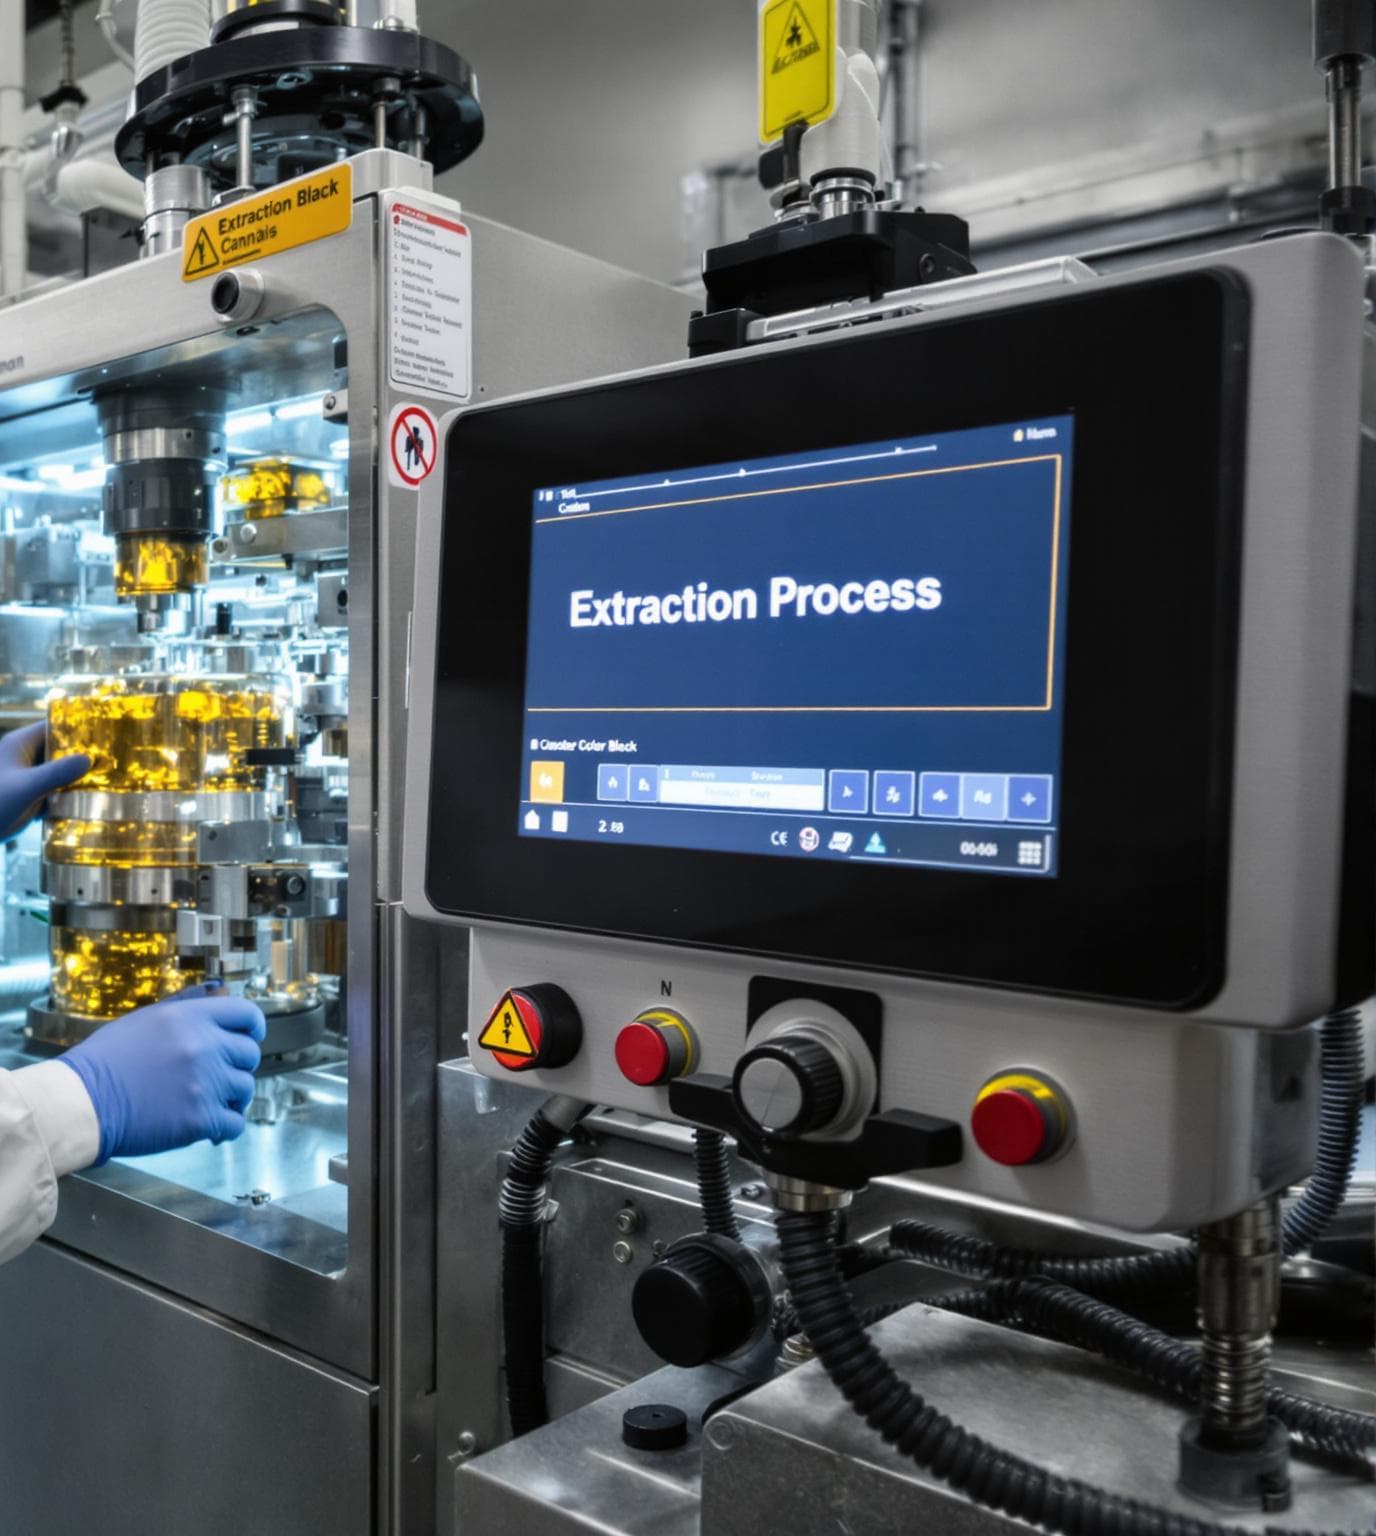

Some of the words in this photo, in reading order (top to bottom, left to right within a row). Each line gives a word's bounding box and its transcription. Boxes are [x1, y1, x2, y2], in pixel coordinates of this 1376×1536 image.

[218, 198, 292, 236] Extraction
[296, 178, 339, 207] Black
[570, 581, 758, 628] Extraction
[769, 576, 943, 618] Process
[660, 979, 673, 997] N
